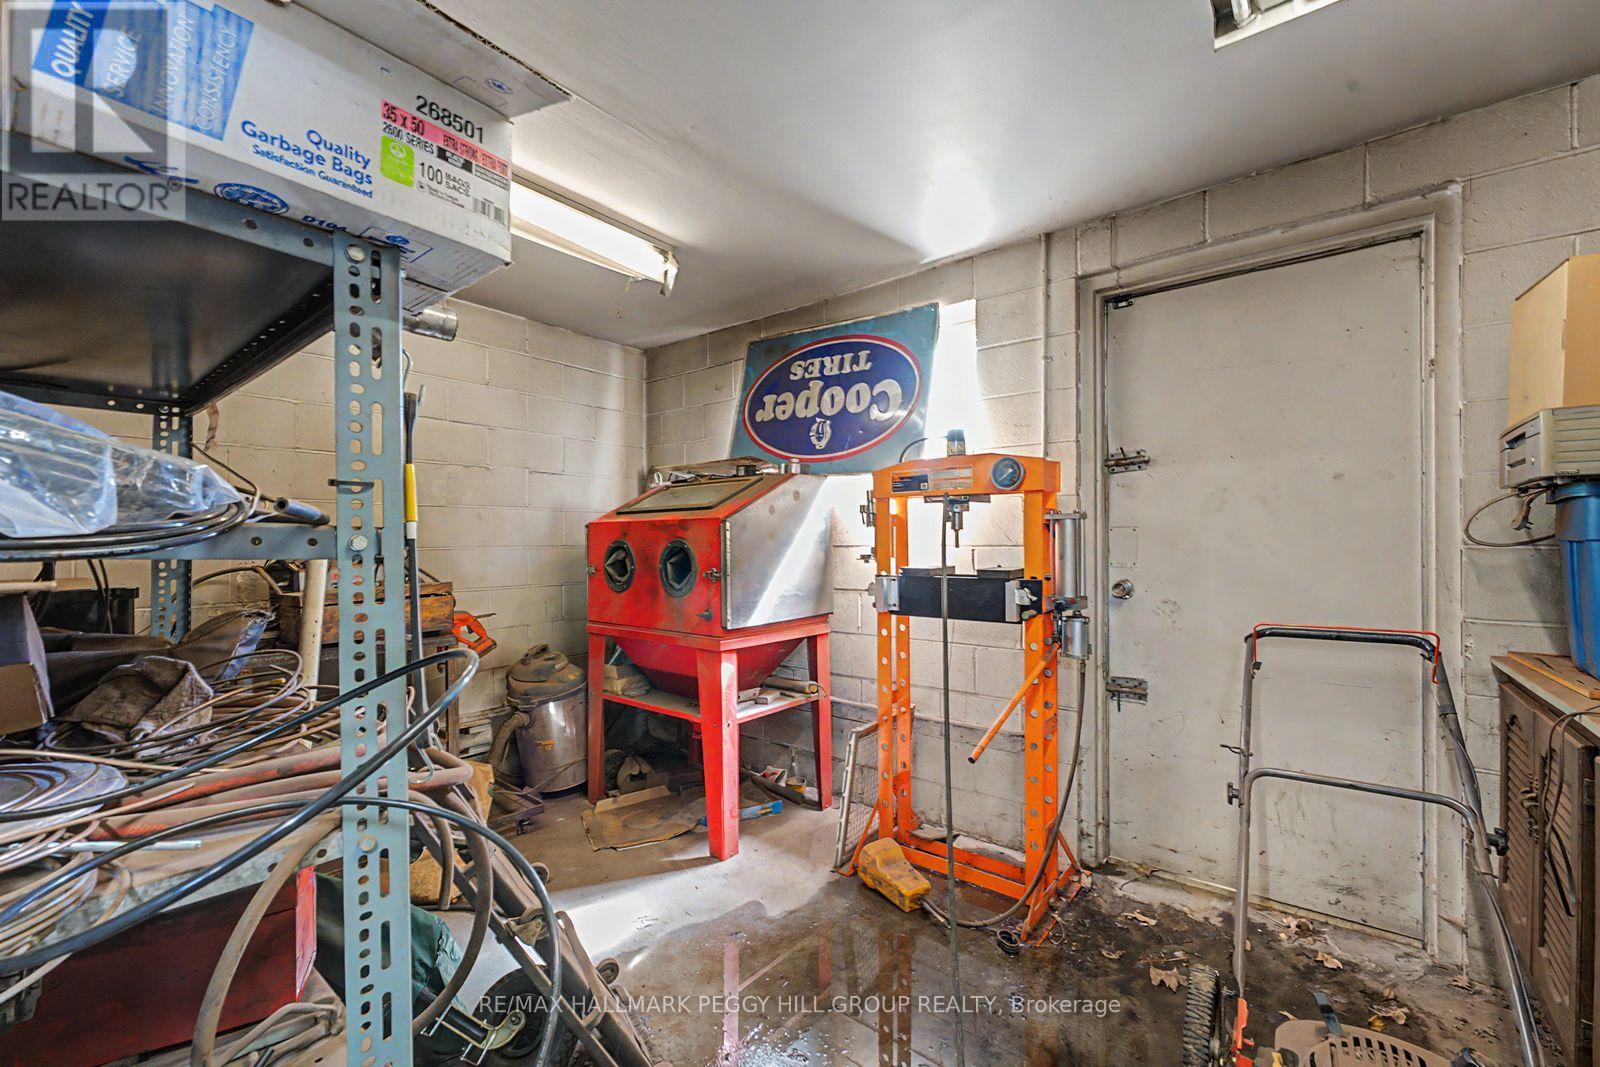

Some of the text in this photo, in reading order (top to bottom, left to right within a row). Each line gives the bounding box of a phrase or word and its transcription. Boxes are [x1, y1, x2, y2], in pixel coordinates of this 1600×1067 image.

[51, 1, 94, 78] QUALITY
[103, 25, 142, 97] SERVICE
[151, 14, 195, 116] INNOVATION
[193, 26, 238, 130] CONSISTENCY
[383, 102, 397, 122] 35
[412, 116, 425, 135] 50
[415, 95, 483, 144] 268501
[241, 120, 374, 186] Garbage Bags
[306, 129, 371, 170] Quality
[405, 133, 434, 154] SERIES
[251, 144, 316, 177] Satisfaction
[318, 170, 373, 199] Guaranteed
[420, 161, 443, 185] 100
[445, 171, 471, 191] BAGS
[445, 180, 471, 198] SACS
[790, 350, 872, 380] TIRES
[755, 379, 902, 421] Cooper
